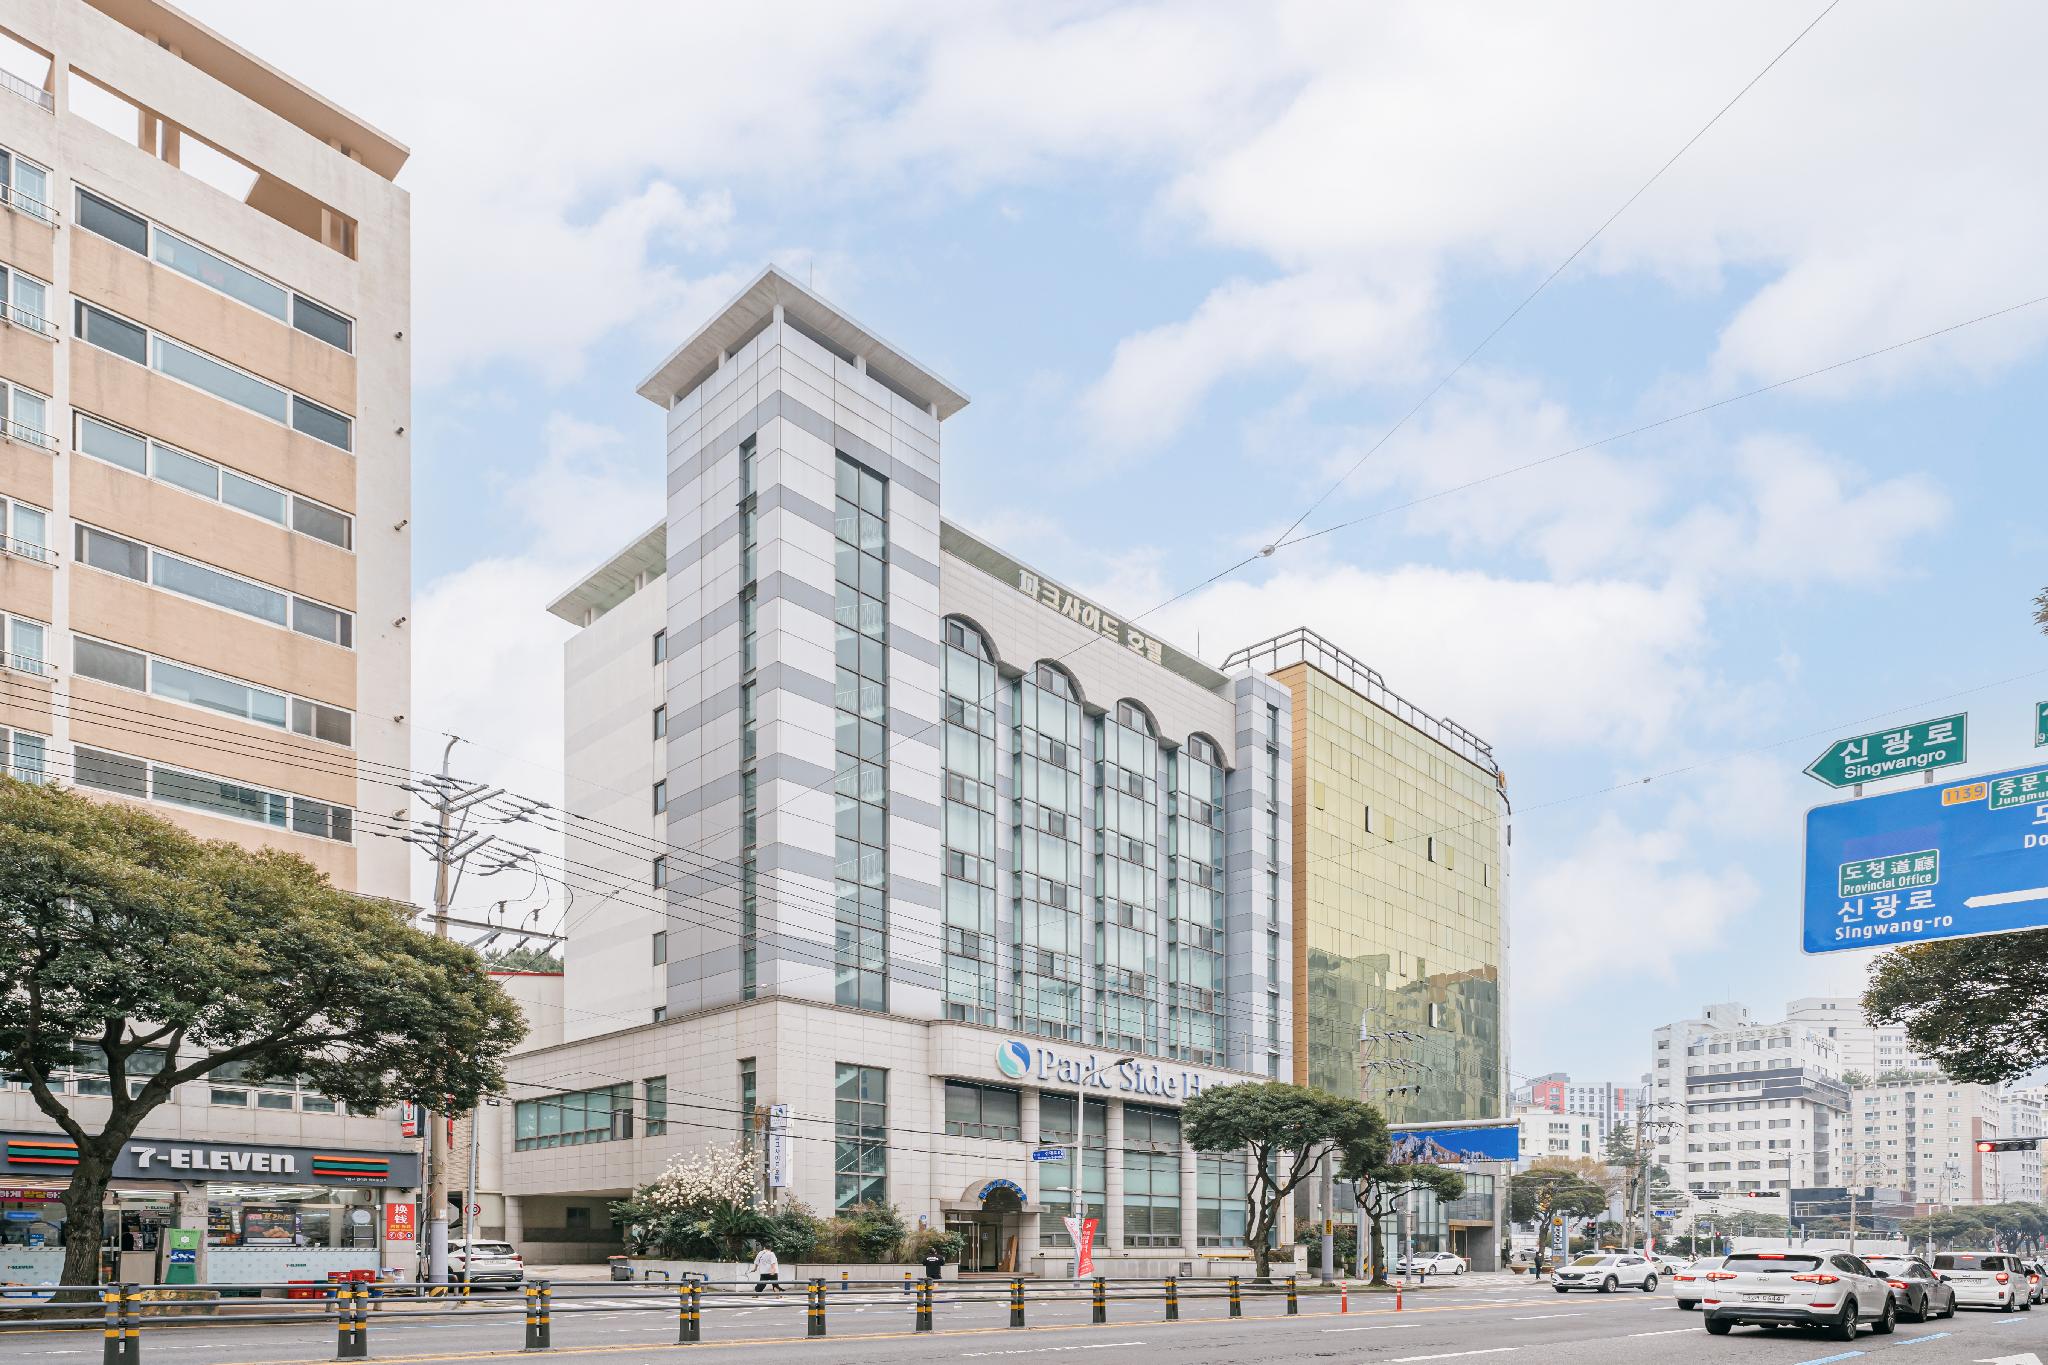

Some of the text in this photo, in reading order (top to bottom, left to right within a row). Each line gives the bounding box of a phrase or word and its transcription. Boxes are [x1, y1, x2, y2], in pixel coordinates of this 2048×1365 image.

[1018, 568, 1162, 666] 파크사이드 호텔
[1840, 722, 1957, 765] 신광로
[1844, 749, 1946, 779] Singwangro
[1945, 785, 1984, 802] 1139
[1844, 861, 1885, 880] 도청
[1844, 874, 1932, 895] Provincial Office
[1838, 889, 1936, 923] 신광로
[1835, 915, 1953, 941] Singwang-ro
[1037, 1047, 1112, 1089] Park
[1120, 1061, 1178, 1099] Side
